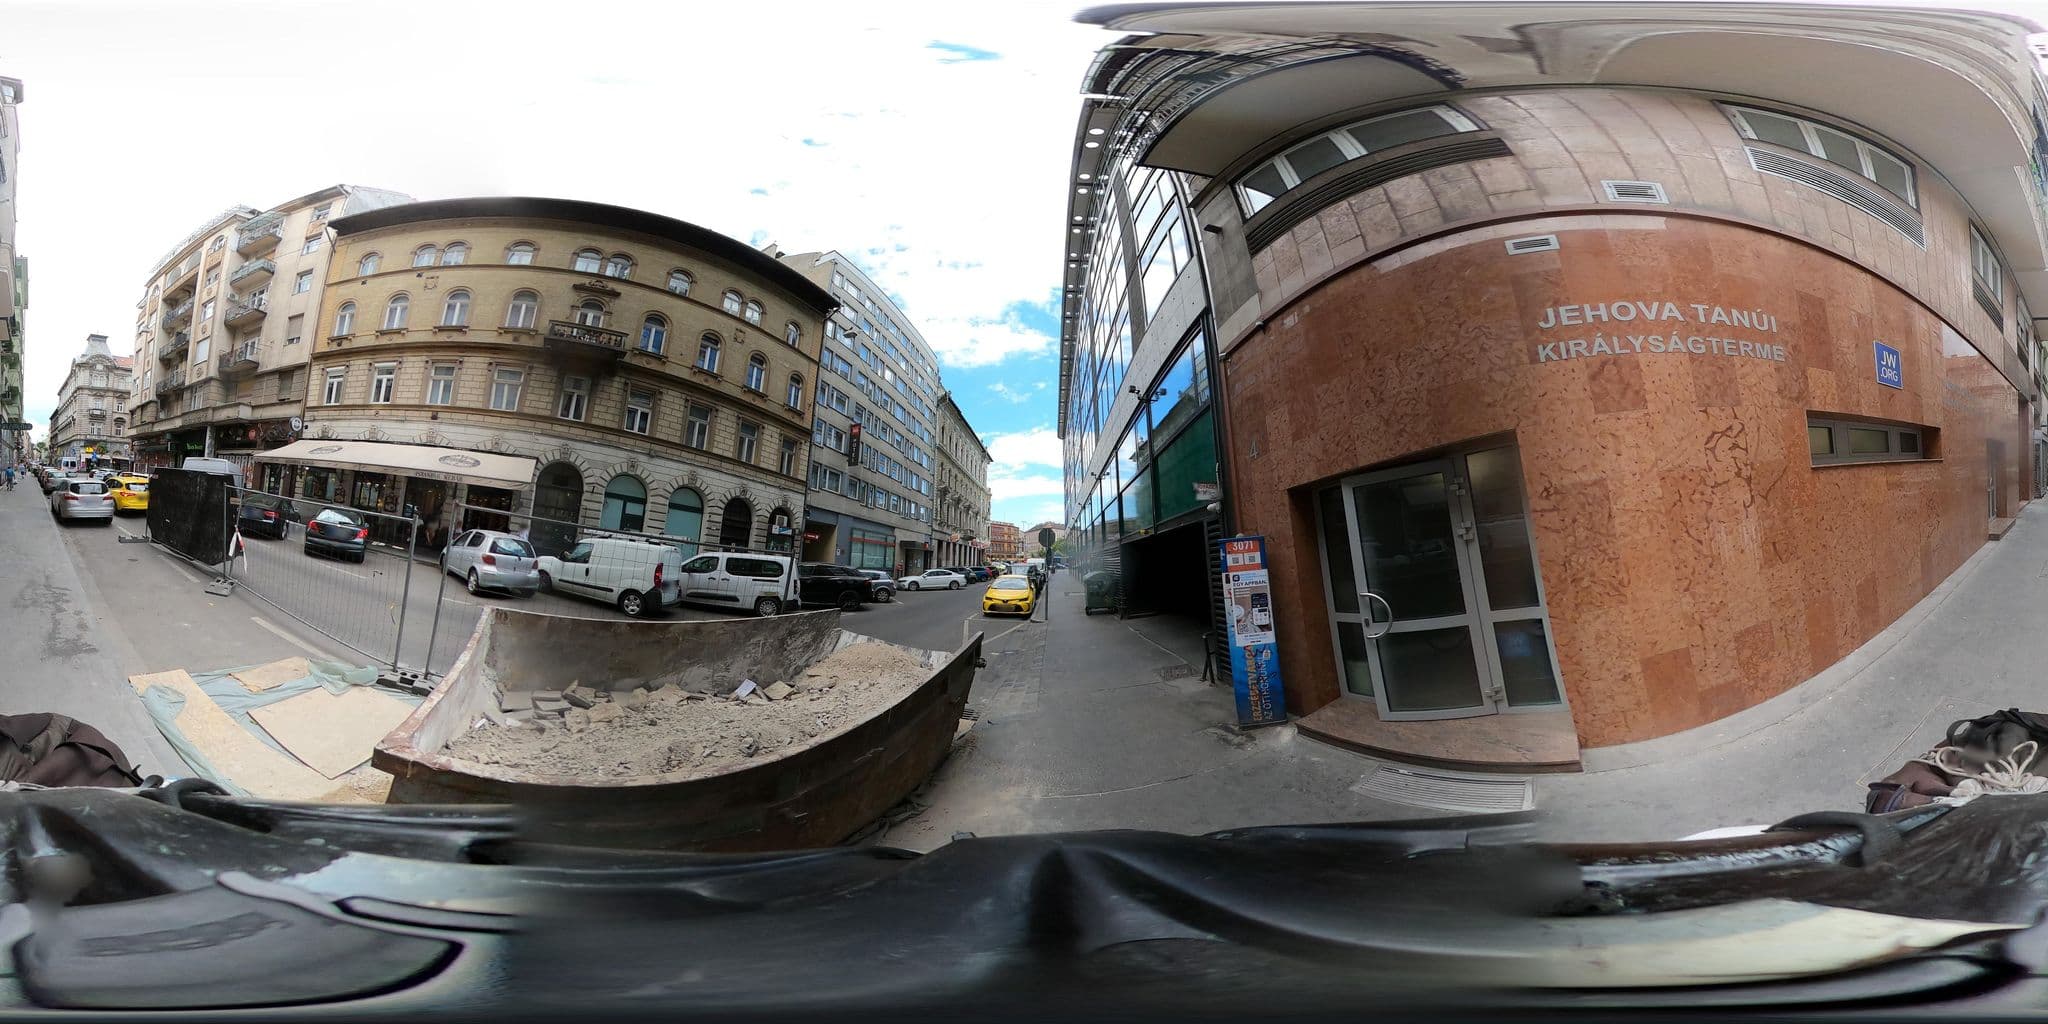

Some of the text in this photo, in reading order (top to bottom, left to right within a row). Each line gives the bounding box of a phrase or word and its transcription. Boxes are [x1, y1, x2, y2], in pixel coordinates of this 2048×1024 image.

[1538, 300, 1778, 333] JEHOVA TANÚI
[1537, 331, 1786, 363] KIRÁLYSÁGTERME
[1880, 350, 1897, 369] JW
[1880, 366, 1899, 382] .ORG
[1249, 440, 1259, 459] 4
[1232, 540, 1254, 551] 3071
